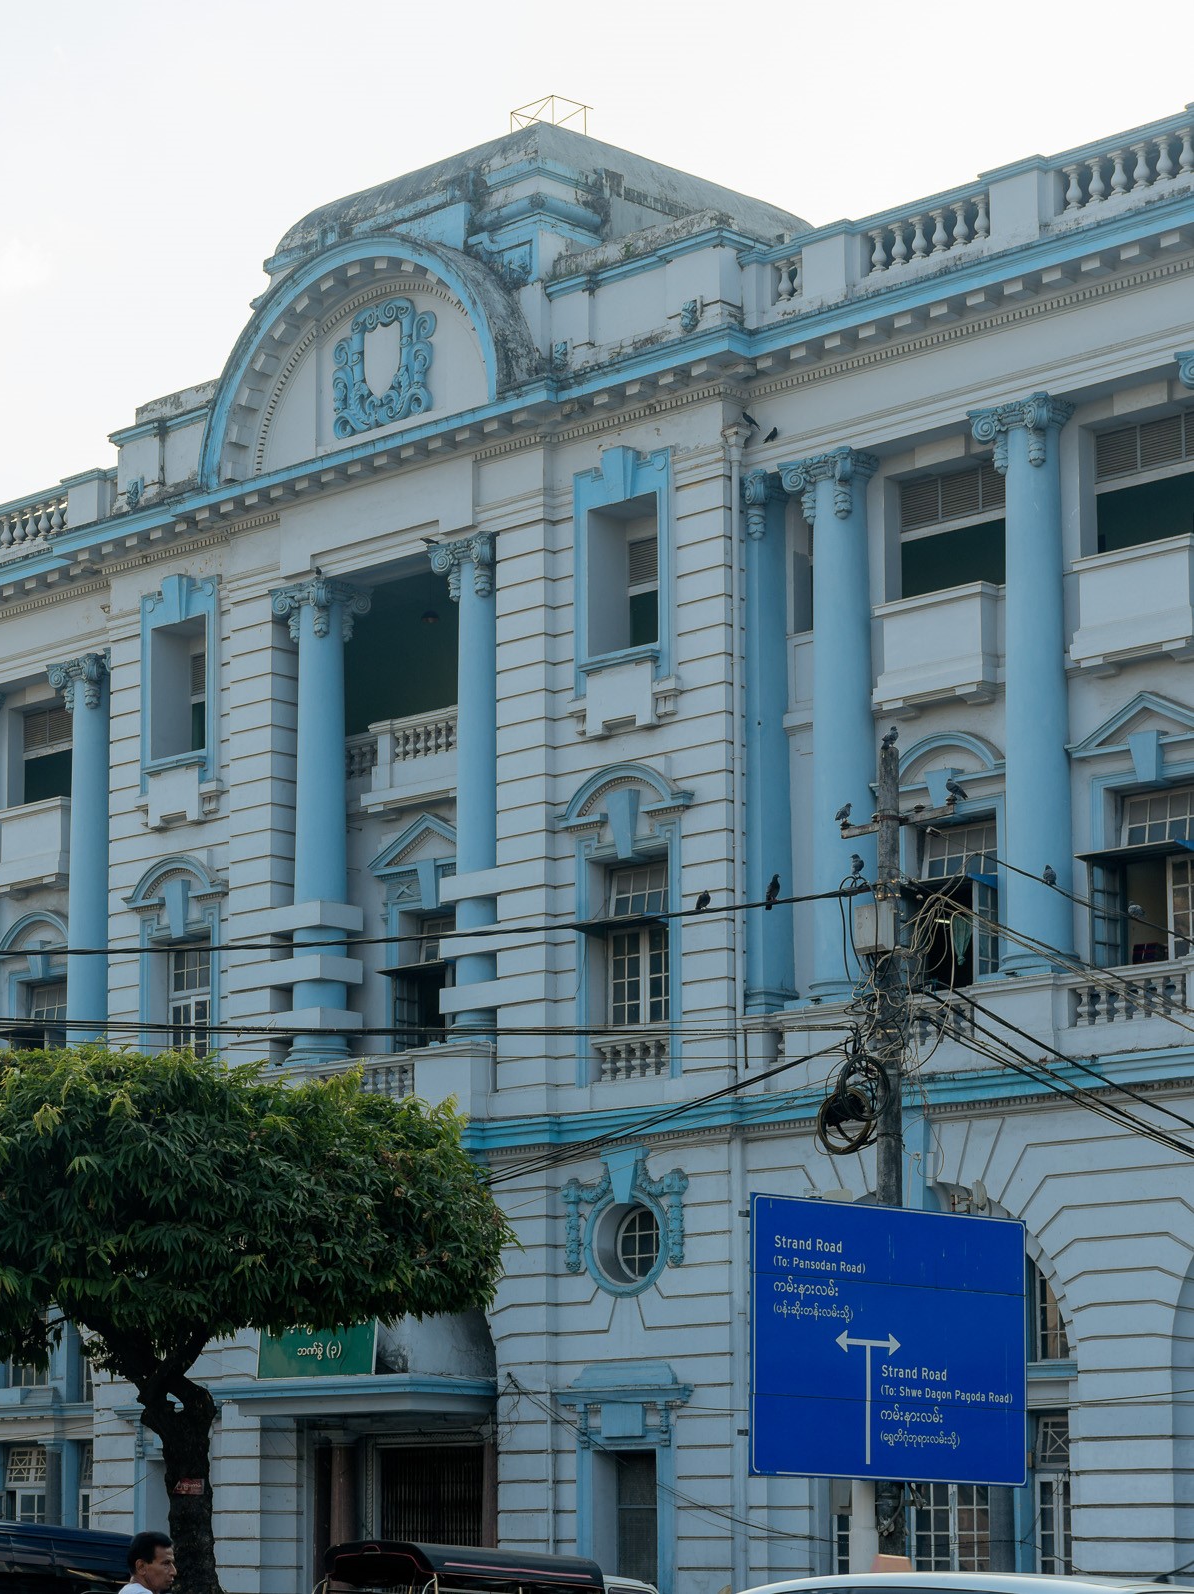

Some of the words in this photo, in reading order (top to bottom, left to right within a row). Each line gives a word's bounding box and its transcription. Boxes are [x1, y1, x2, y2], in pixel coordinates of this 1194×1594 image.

[774, 1235, 812, 1251] Strand
[816, 1239, 843, 1253] Road
[773, 1255, 790, 1267] (To:
[793, 1257, 837, 1271] Pansodan
[840, 1261, 866, 1274] Road)
[773, 1275, 839, 1300] ကမ်းနားလမ်း
[881, 1364, 918, 1379] Strand
[921, 1367, 947, 1381] Road
[880, 1384, 897, 1396] (To:
[899, 1386, 922, 1398] Shwe
[925, 1387, 952, 1402] Dagon
[954, 1389, 986, 1404] Pagoda
[988, 1391, 1013, 1404] Road)
[880, 1403, 944, 1428] ကမ်းနားလမ်း
